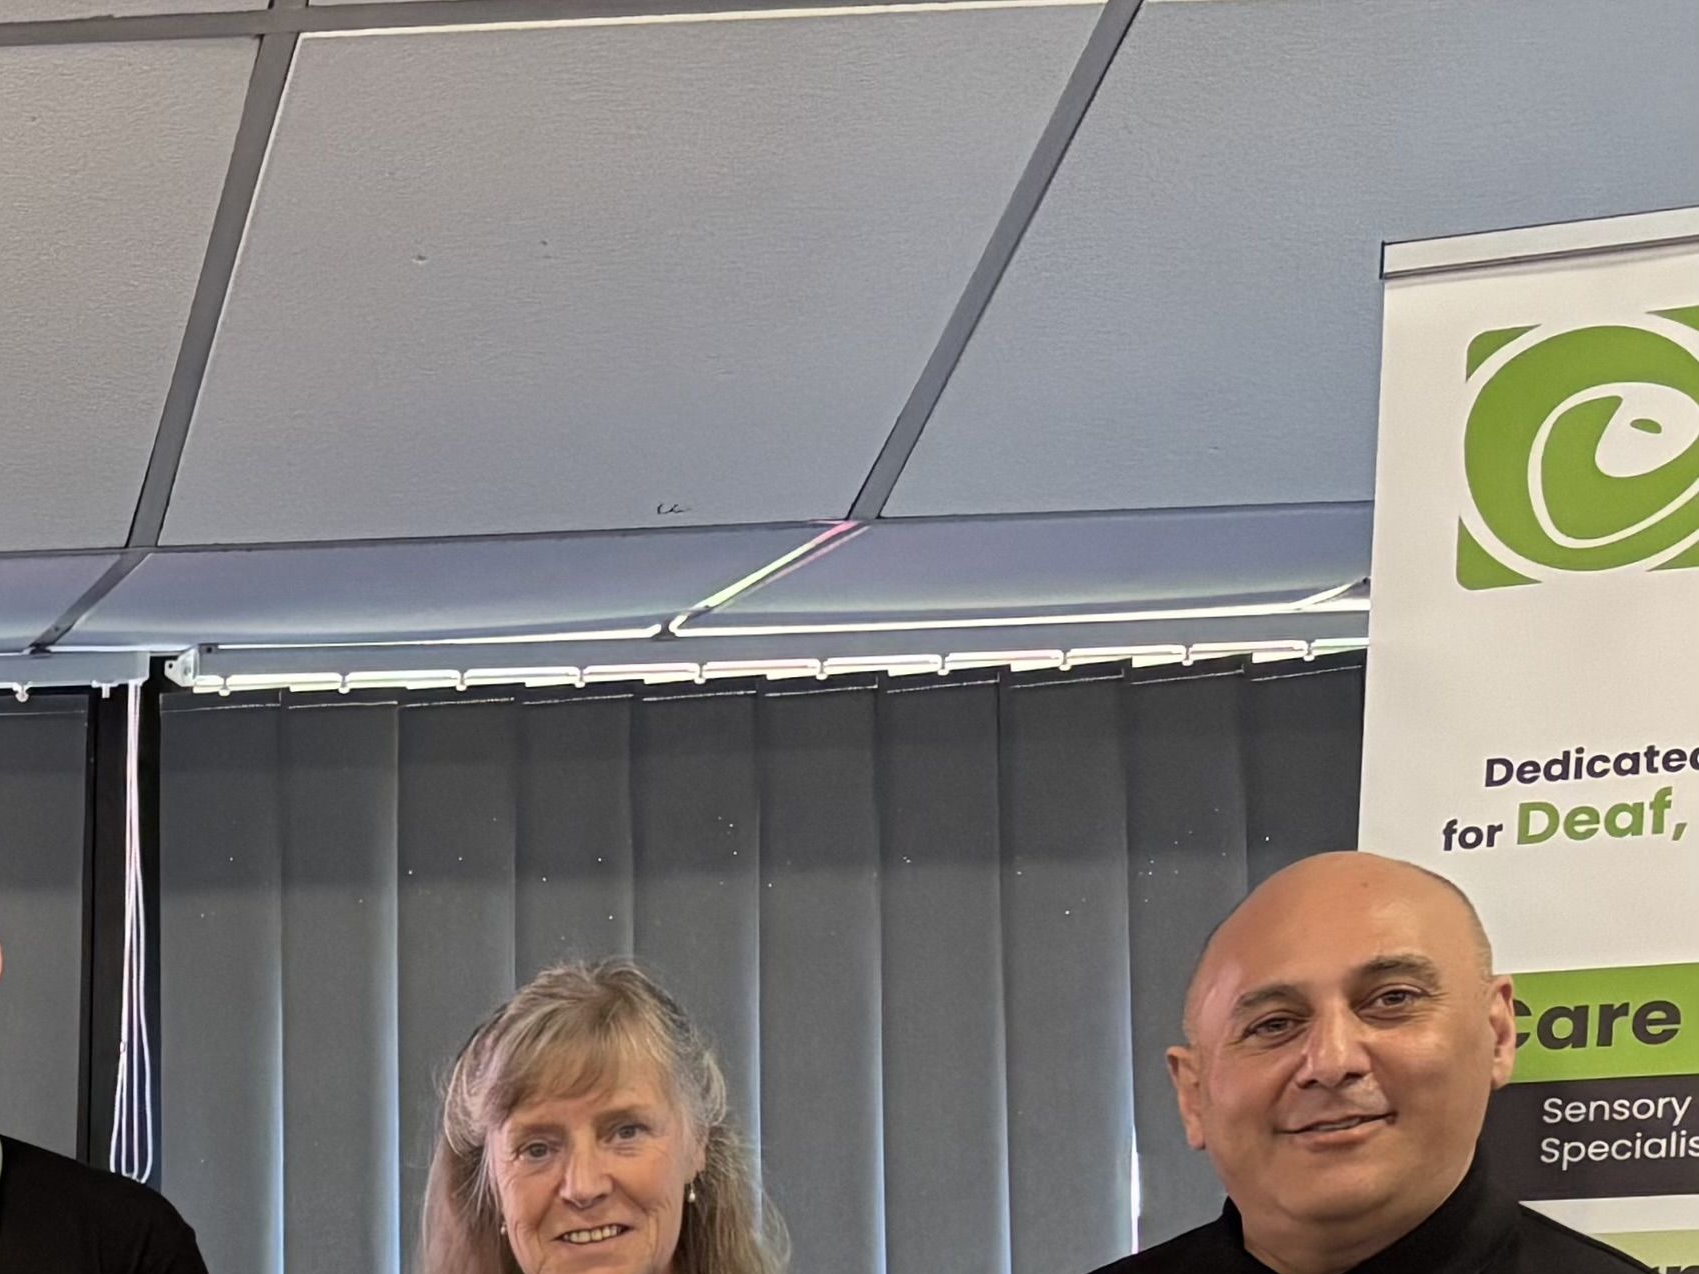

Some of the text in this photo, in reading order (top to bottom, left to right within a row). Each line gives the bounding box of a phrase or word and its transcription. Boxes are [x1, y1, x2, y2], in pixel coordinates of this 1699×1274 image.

[1443, 786, 1688, 851] for Deaf,
[1543, 1094, 1691, 1127] Sensory
